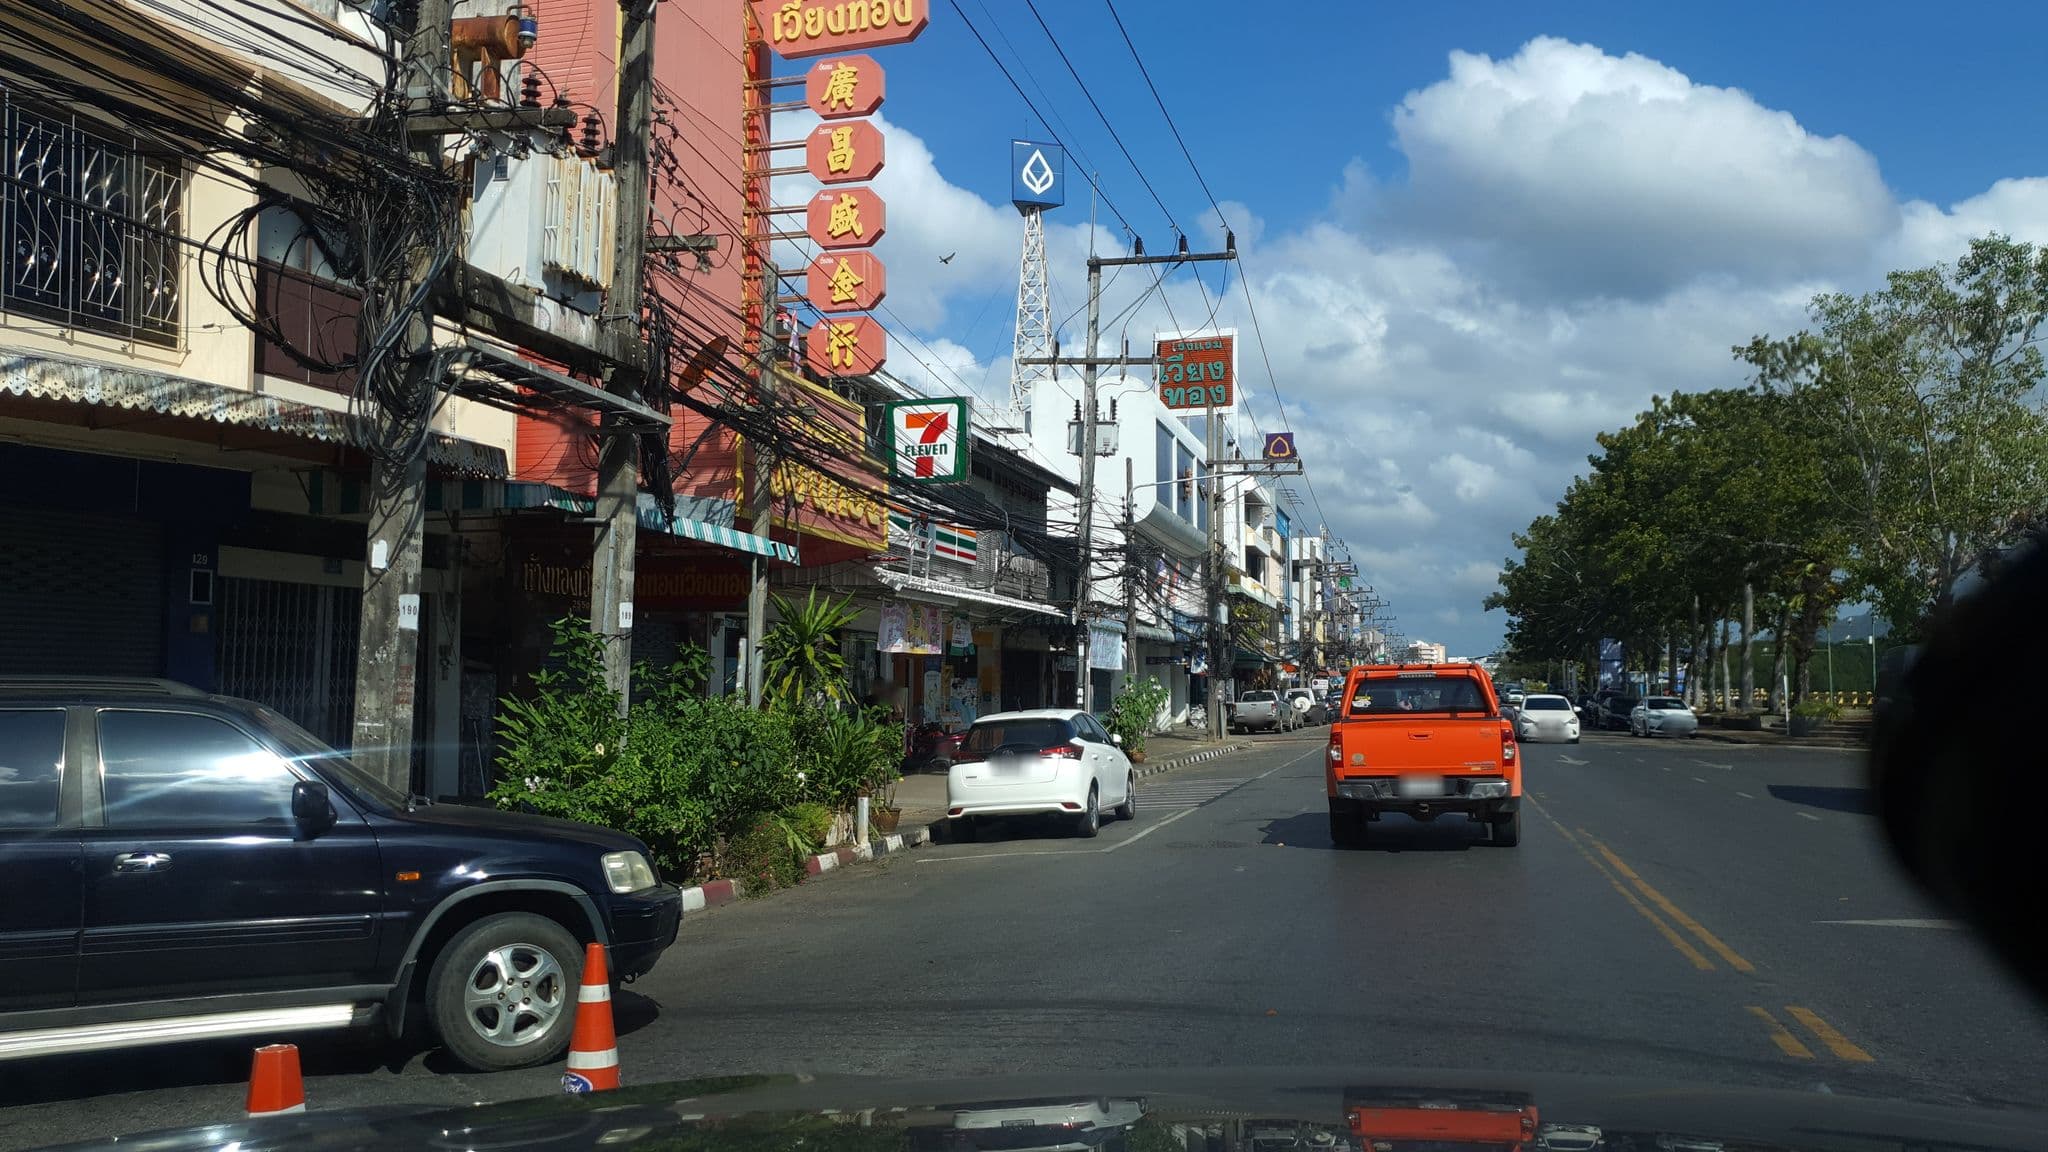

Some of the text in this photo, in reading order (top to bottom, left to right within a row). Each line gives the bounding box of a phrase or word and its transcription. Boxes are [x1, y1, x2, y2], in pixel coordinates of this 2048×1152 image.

[772, 0, 913, 42] เวียงทอง
[1160, 353, 1226, 384] เวียง
[1163, 384, 1227, 406] ทอง
[192, 553, 208, 565] 129
[402, 605, 417, 615] 190
